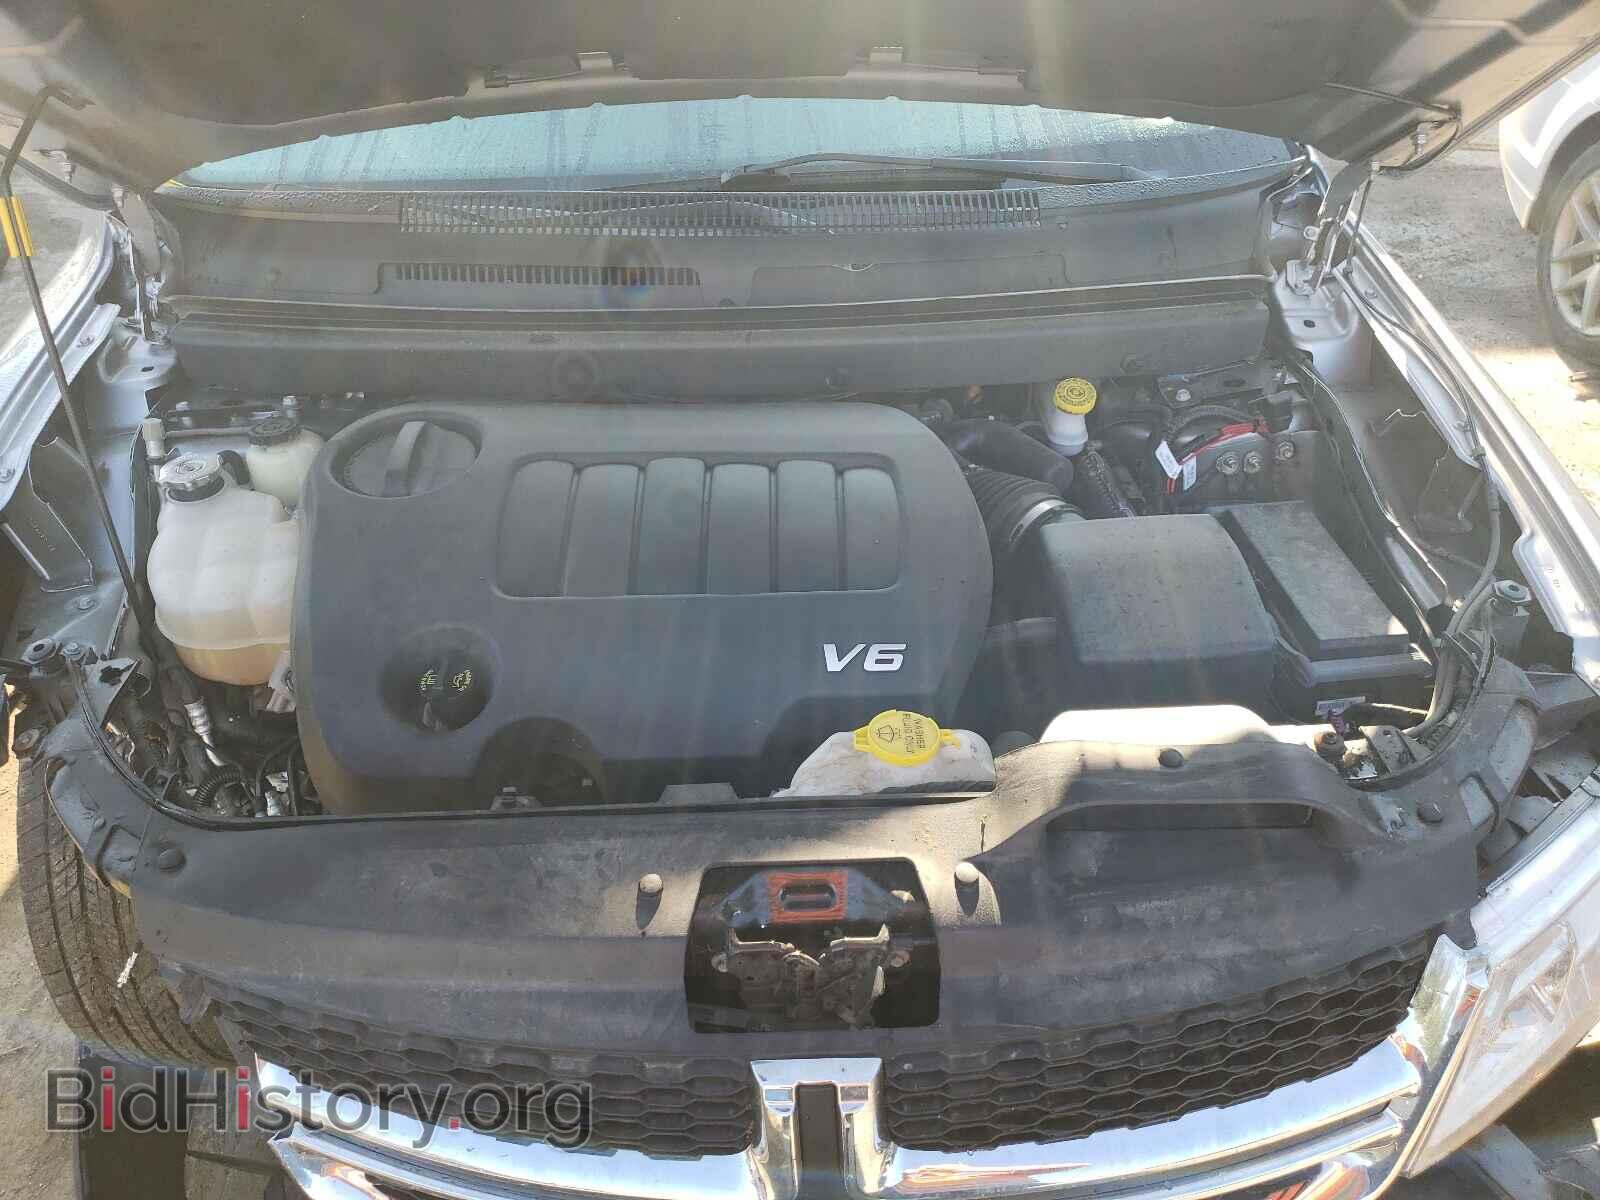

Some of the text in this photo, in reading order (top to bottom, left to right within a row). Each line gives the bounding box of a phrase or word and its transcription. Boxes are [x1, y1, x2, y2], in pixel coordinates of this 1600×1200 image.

[823, 643, 907, 672] V6
[902, 713, 913, 734] FLUID
[913, 718, 926, 749] WASHER
